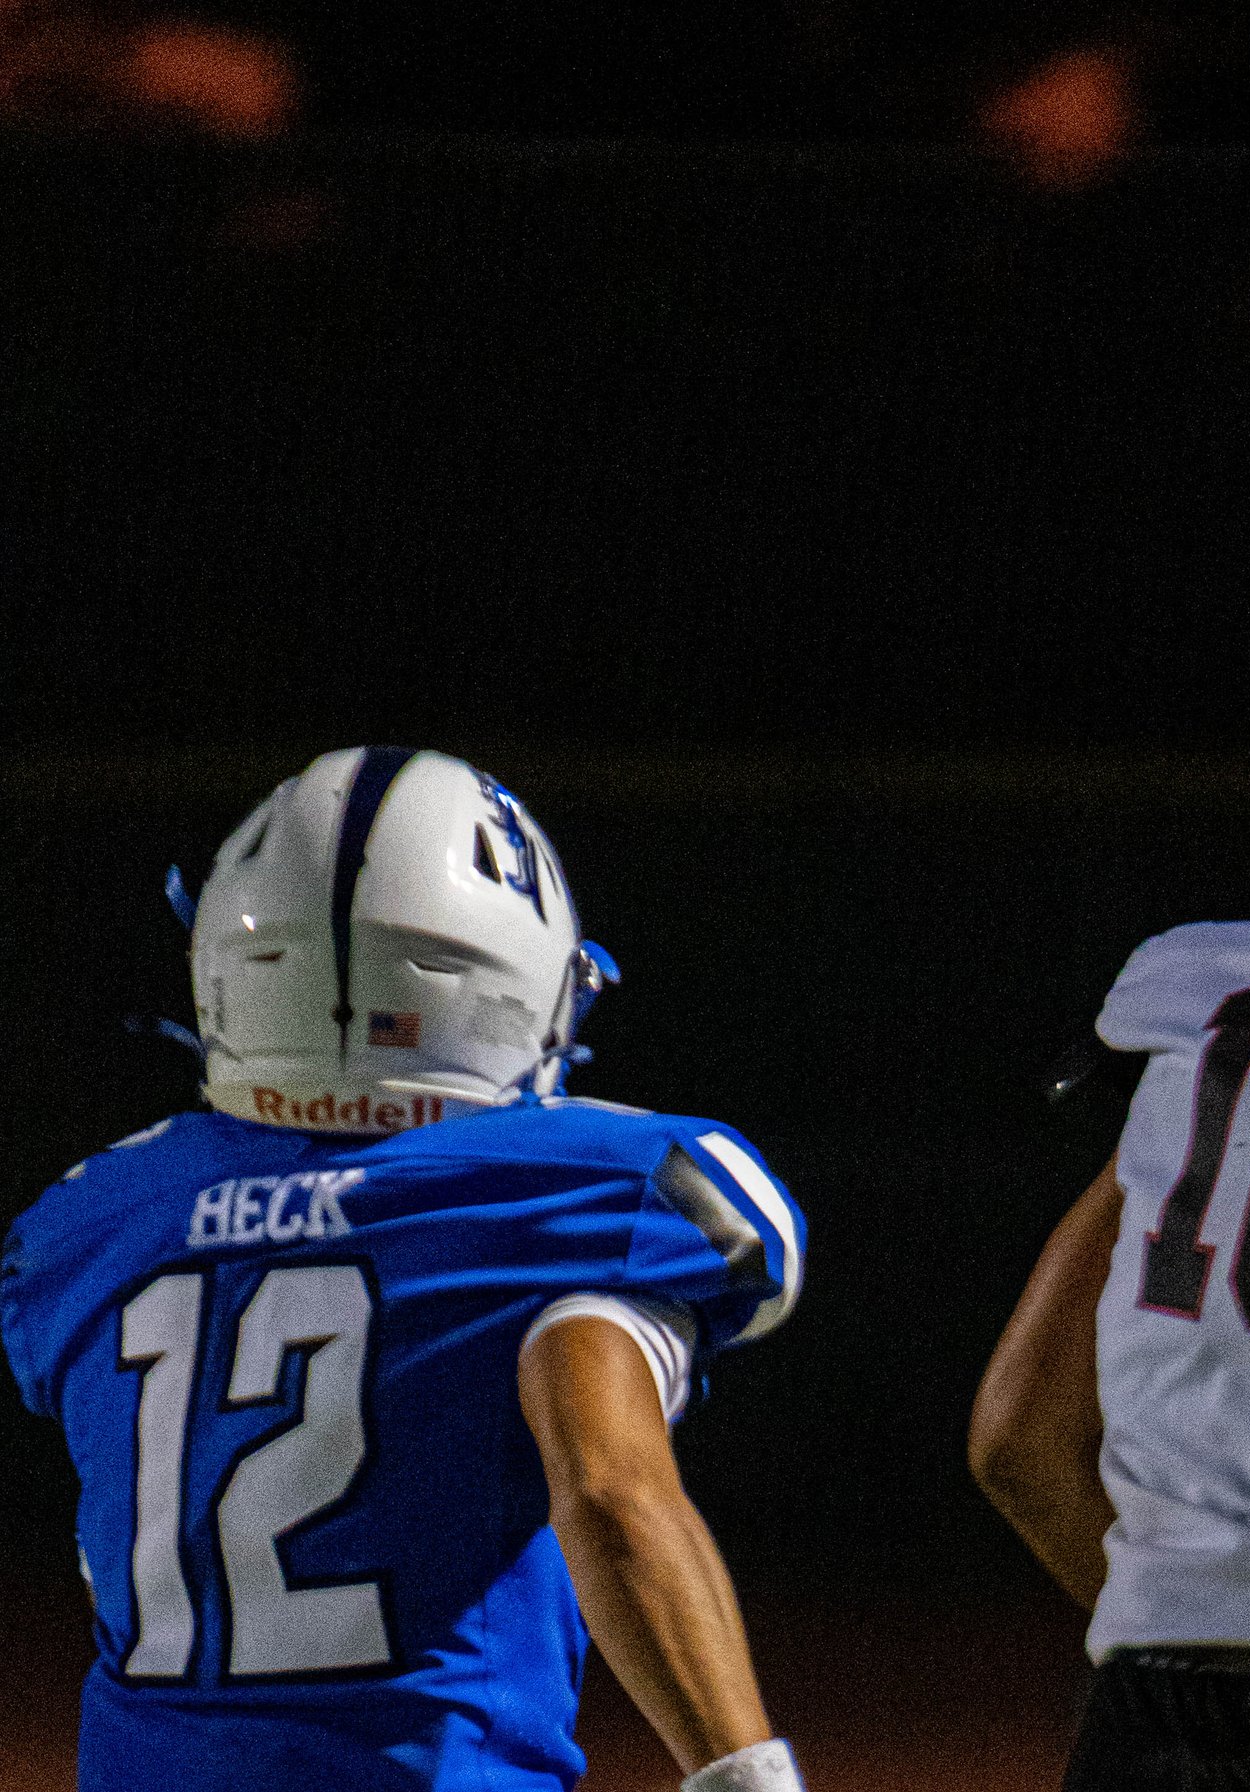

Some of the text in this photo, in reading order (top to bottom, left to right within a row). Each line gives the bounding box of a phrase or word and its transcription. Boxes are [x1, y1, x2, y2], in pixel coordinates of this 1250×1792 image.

[252, 1086, 443, 1128] Riddell
[186, 1168, 366, 1247] HECK
[119, 1264, 392, 1680] 12
